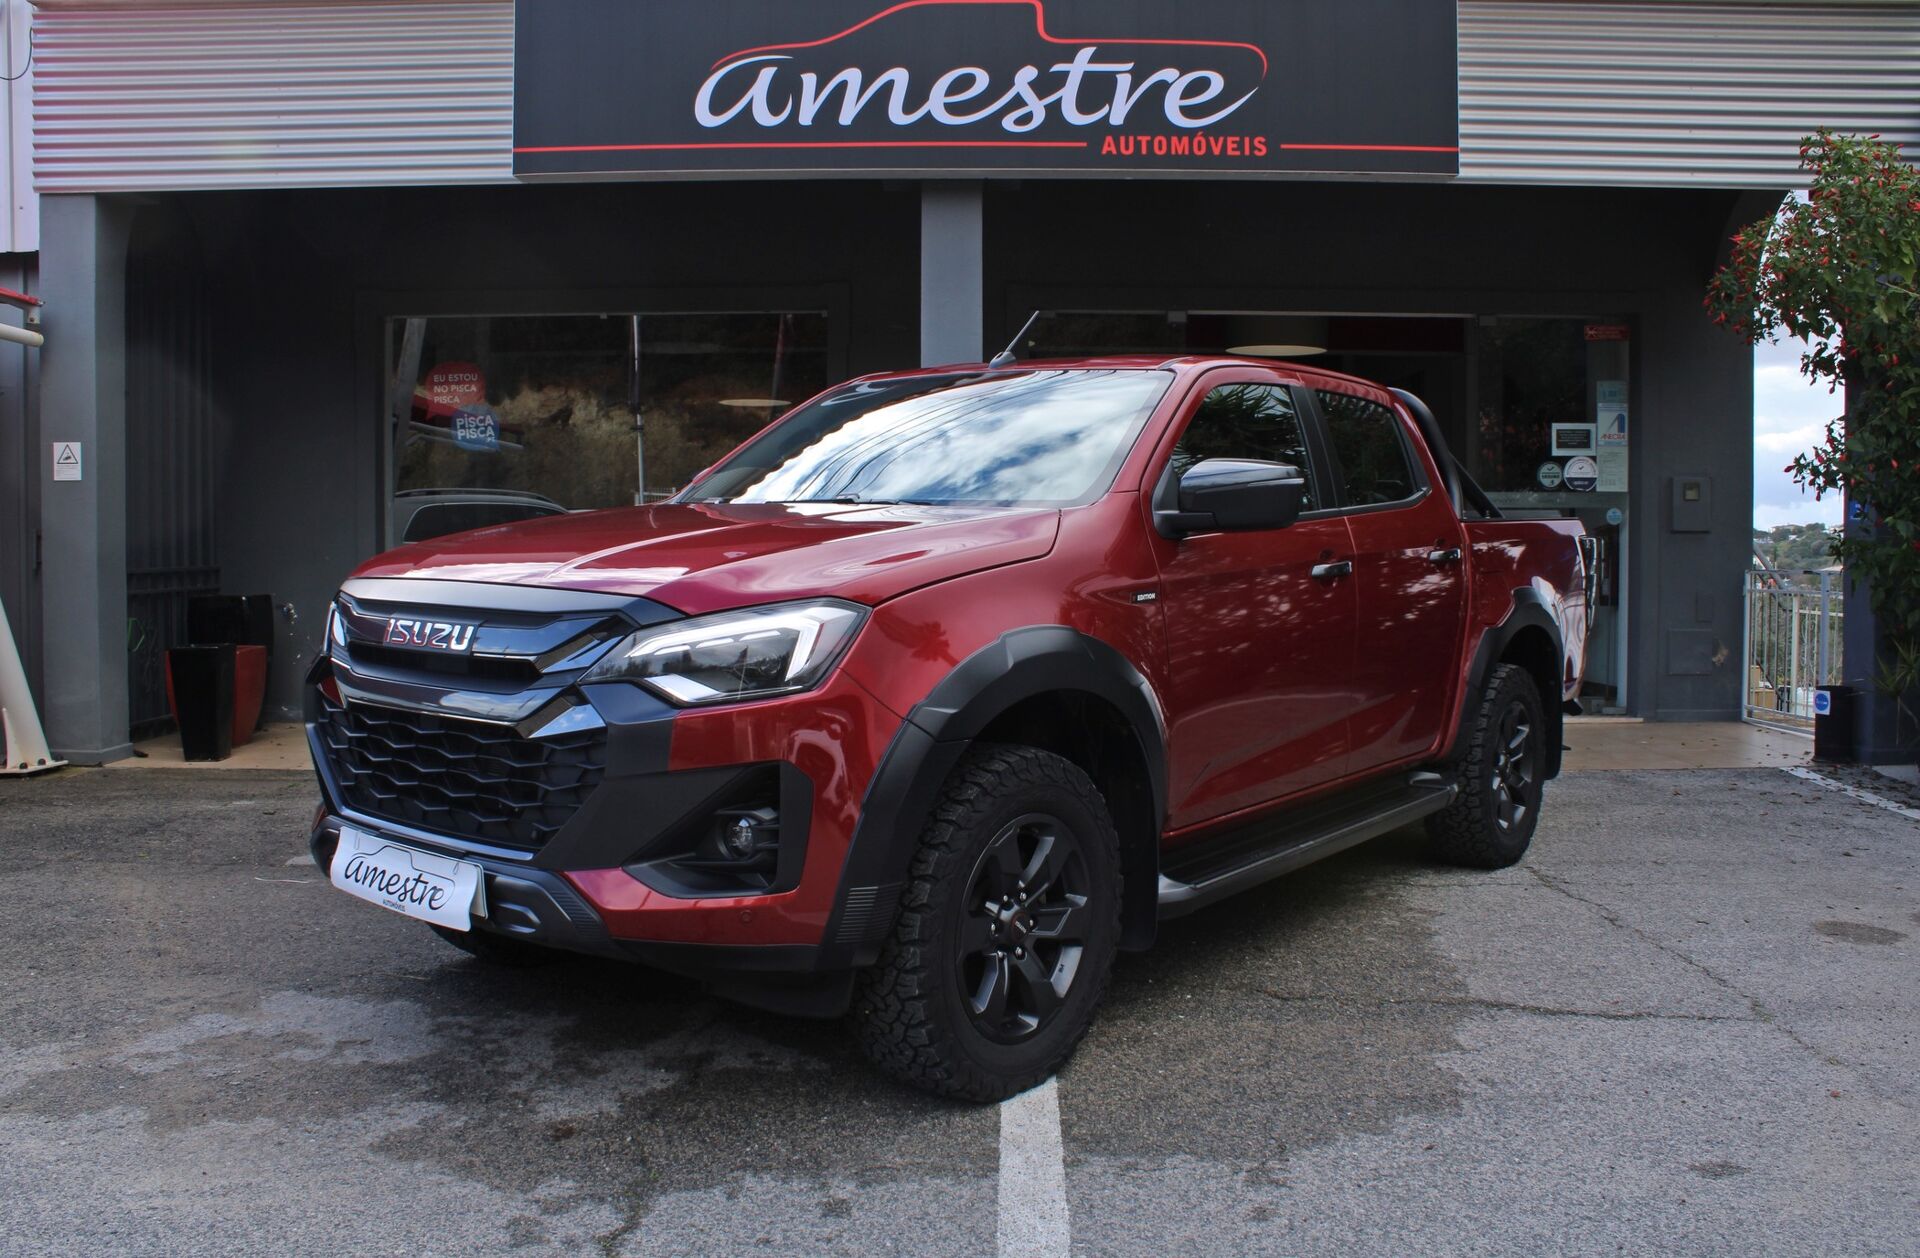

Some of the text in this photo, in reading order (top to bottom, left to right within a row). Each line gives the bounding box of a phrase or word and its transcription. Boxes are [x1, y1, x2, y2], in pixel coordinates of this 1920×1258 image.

[694, 46, 1259, 133] amestre
[1101, 131, 1268, 156] AUTOMÓVEIS
[433, 373, 478, 383] EU ESTOU
[433, 384, 477, 393] NO PISCA
[433, 396, 460, 404] PISCA
[456, 414, 494, 429] PISCA
[457, 426, 495, 440] PISCA
[384, 618, 474, 651] ISUZU
[344, 856, 452, 910] amestre
